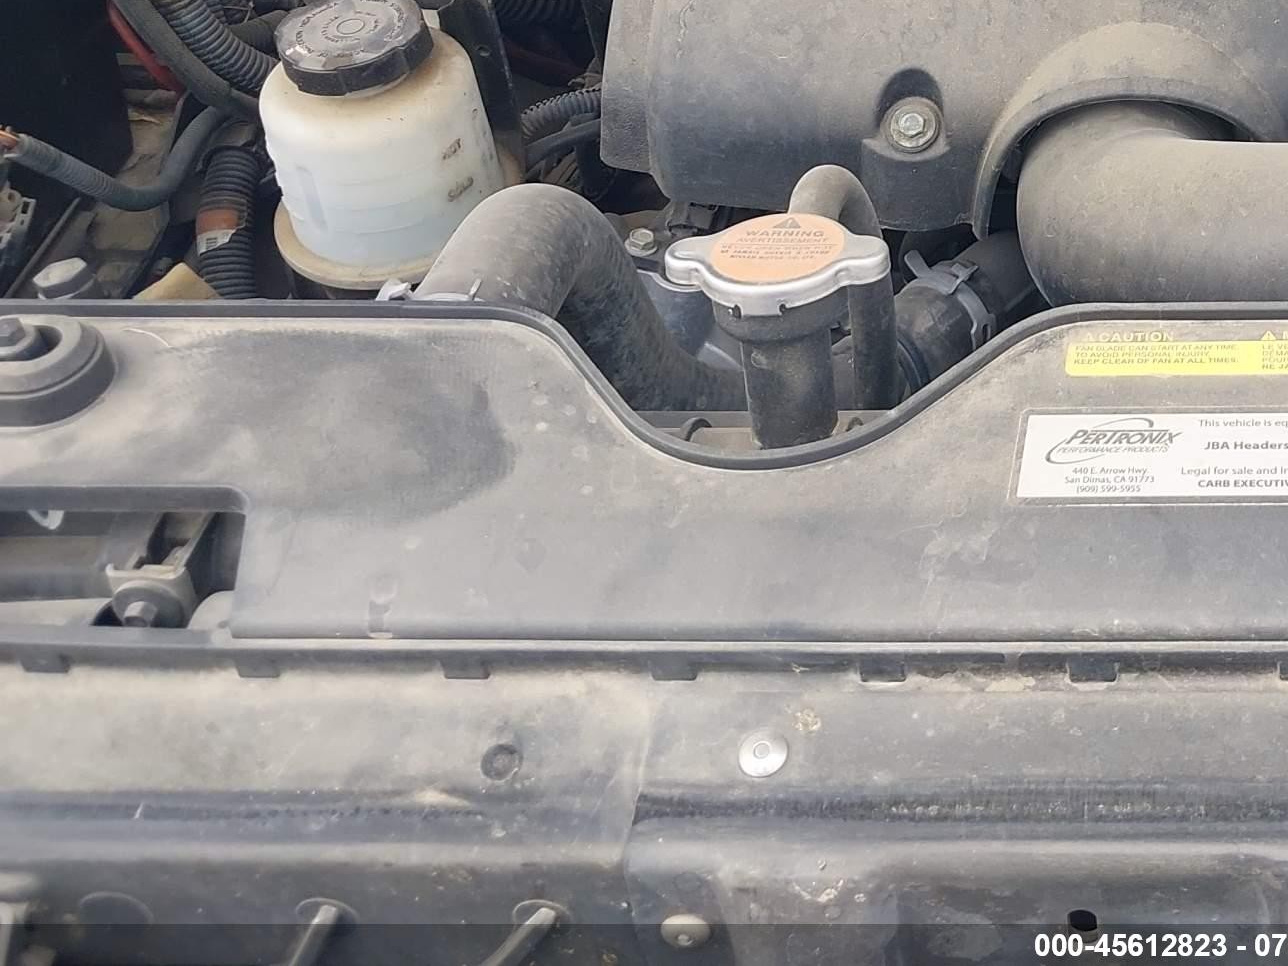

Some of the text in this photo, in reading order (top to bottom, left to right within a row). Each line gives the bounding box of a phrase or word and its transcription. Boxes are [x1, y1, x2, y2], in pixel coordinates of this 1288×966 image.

[746, 229, 825, 237] WARNING
[1098, 331, 1174, 342] CAUTION
[1199, 418, 1220, 427] This
[1223, 418, 1261, 427] vehicle
[1264, 418, 1272, 427] is
[1056, 445, 1171, 454] PERFORMANCE PRODUCTS
[1204, 441, 1230, 450] JBA
[1234, 440, 1288, 450] Headers
[1072, 467, 1089, 475] 440
[1100, 467, 1126, 475] Arrow
[1181, 466, 1211, 477] Legal
[1214, 466, 1229, 475] for
[1232, 466, 1254, 475] sale
[1256, 466, 1277, 475] and
[1065, 476, 1081, 484] San
[1082, 475, 1112, 485] Dimas,
[1128, 475, 1155, 484] 91773
[1198, 479, 1231, 488] CARB
[1076, 484, 1141, 494] (909) 599-5955
